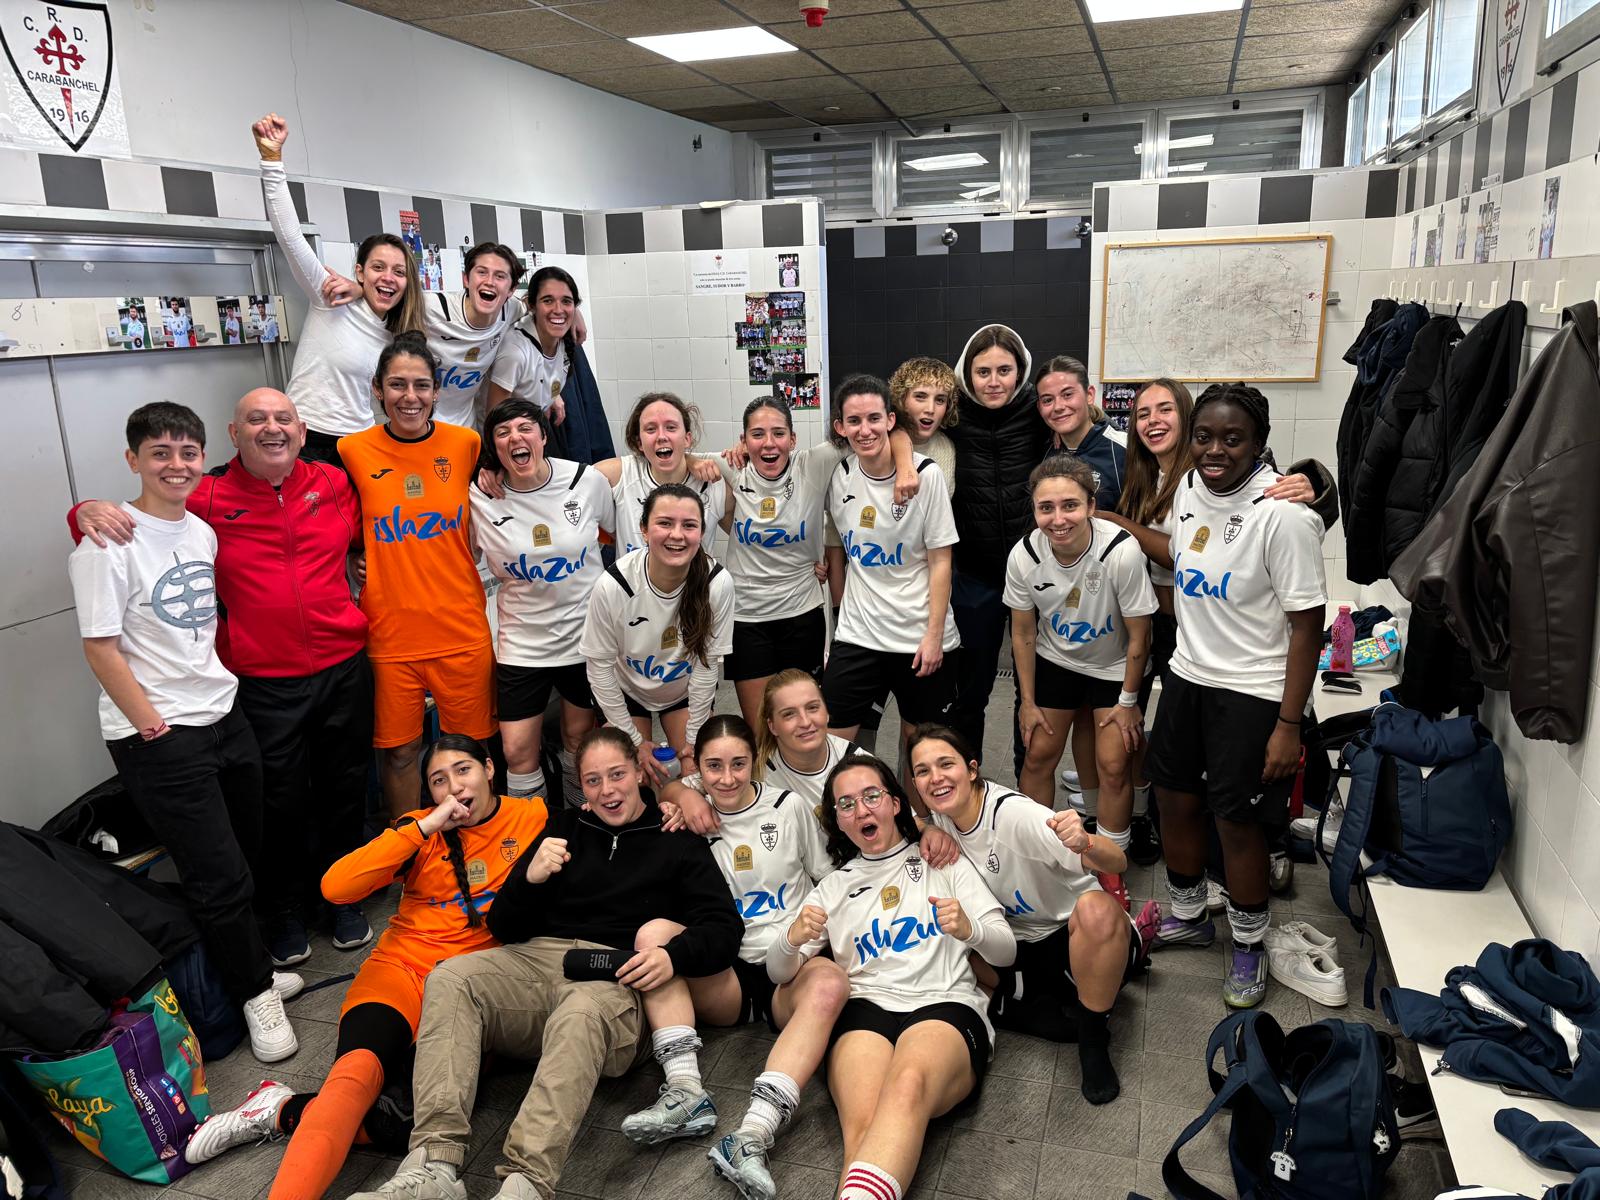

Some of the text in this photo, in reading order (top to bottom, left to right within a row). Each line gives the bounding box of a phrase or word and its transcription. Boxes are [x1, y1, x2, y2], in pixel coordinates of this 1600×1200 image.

[23, 6, 88, 44] C. R. D.
[27, 69, 101, 93] CARABANCHEL
[373, 504, 463, 543] islaZul
[503, 546, 587, 583] islaZul
[841, 529, 904, 567] slaZul
[589, 953, 612, 970] JBL
[1241, 983, 1265, 999] F50
[128, 1068, 156, 1115] SERVIGROUP
[151, 1111, 169, 1148] HOTELES
[1279, 1163, 1286, 1172] 3
